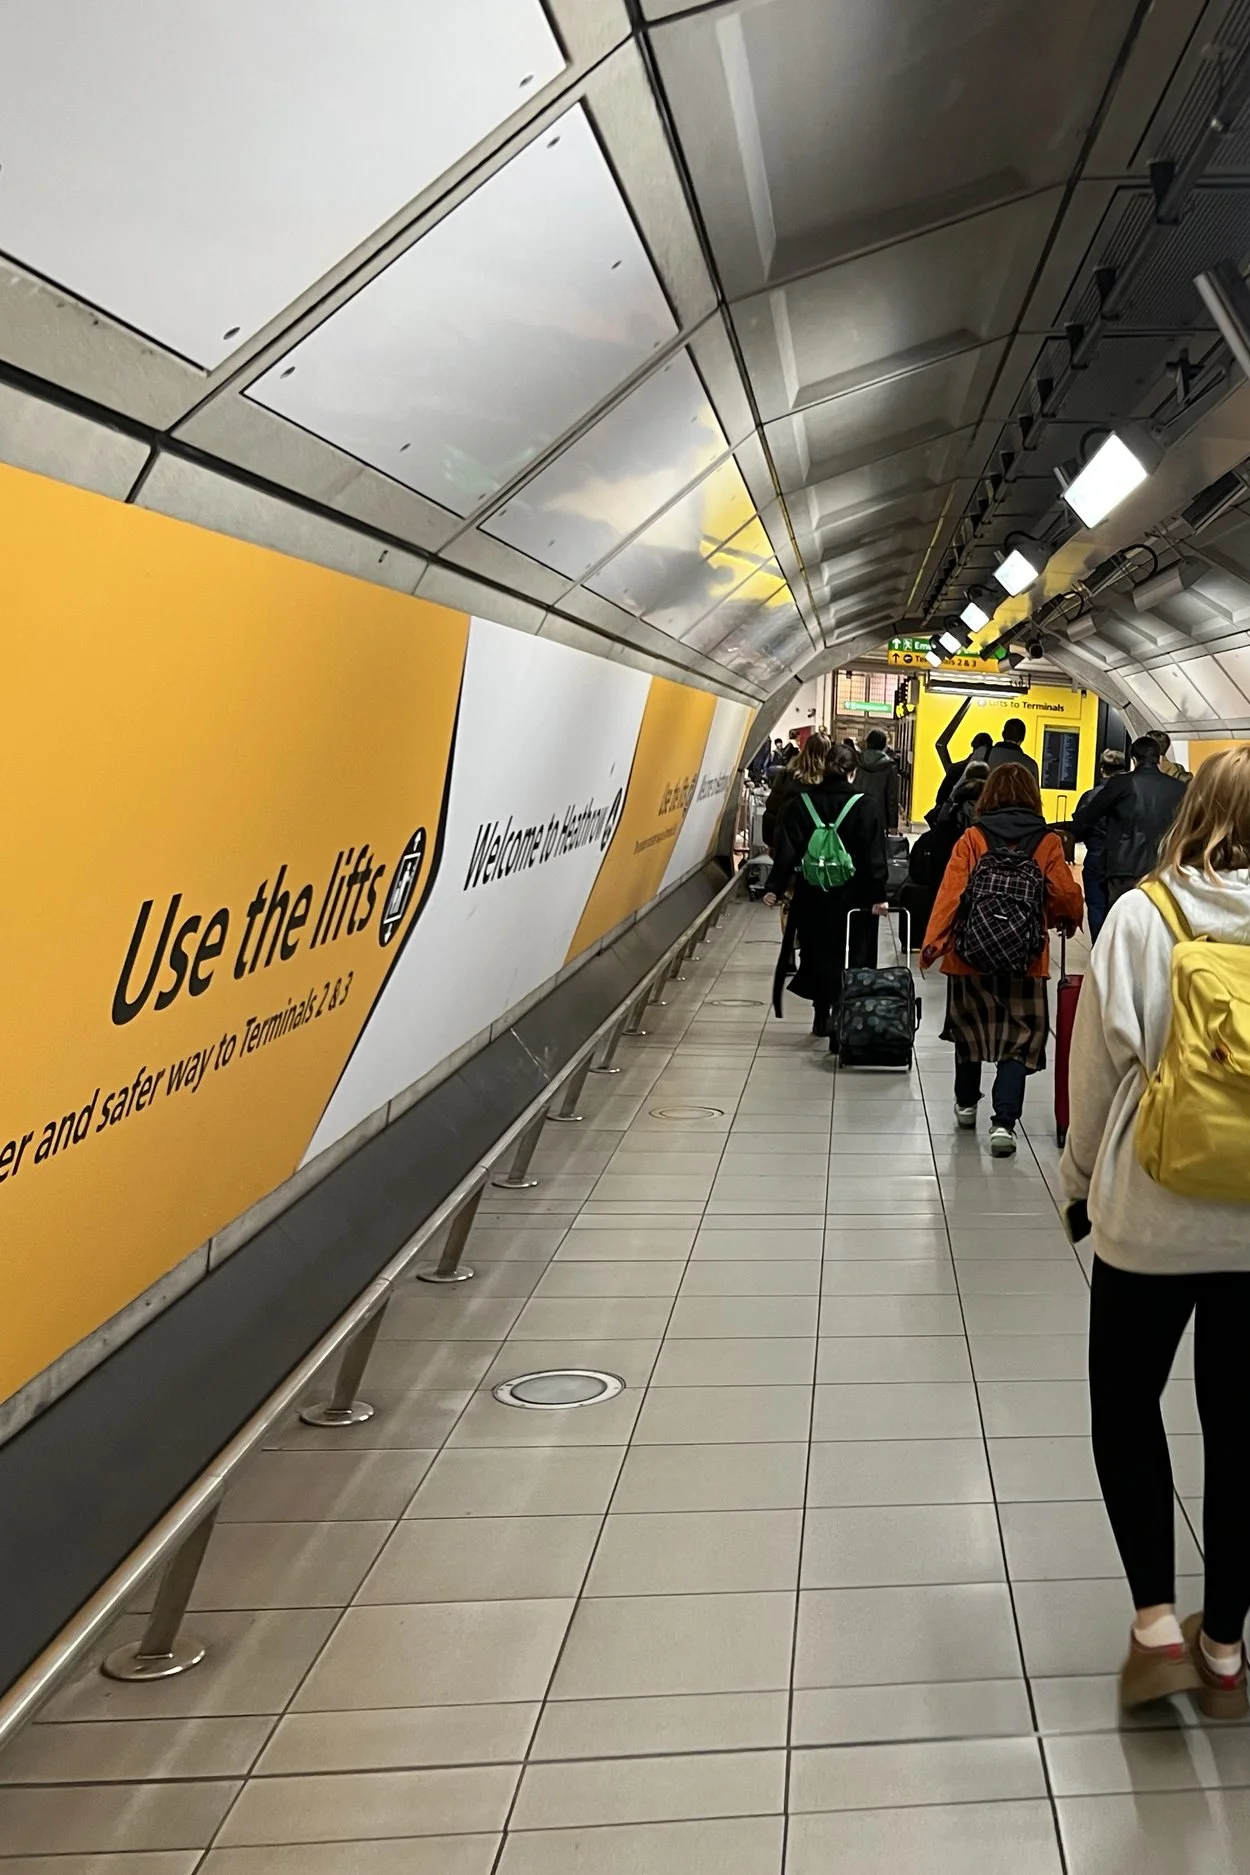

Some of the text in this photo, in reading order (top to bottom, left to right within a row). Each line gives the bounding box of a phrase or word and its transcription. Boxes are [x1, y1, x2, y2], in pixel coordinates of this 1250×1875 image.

[1010, 701, 1020, 709] to
[1023, 701, 1065, 712] Terminals
[463, 815, 544, 891] Welcome
[539, 813, 560, 864] to
[554, 797, 610, 858] Heathrow
[111, 844, 386, 1026] Use the lifts
[33, 1088, 101, 1165] and
[95, 1066, 166, 1133] safer
[166, 1045, 216, 1093] way
[213, 1033, 237, 1071] to
[239, 987, 318, 1058] Terminals
[314, 981, 331, 1018] 2
[327, 977, 342, 1011] &
[338, 970, 354, 1006] 3
